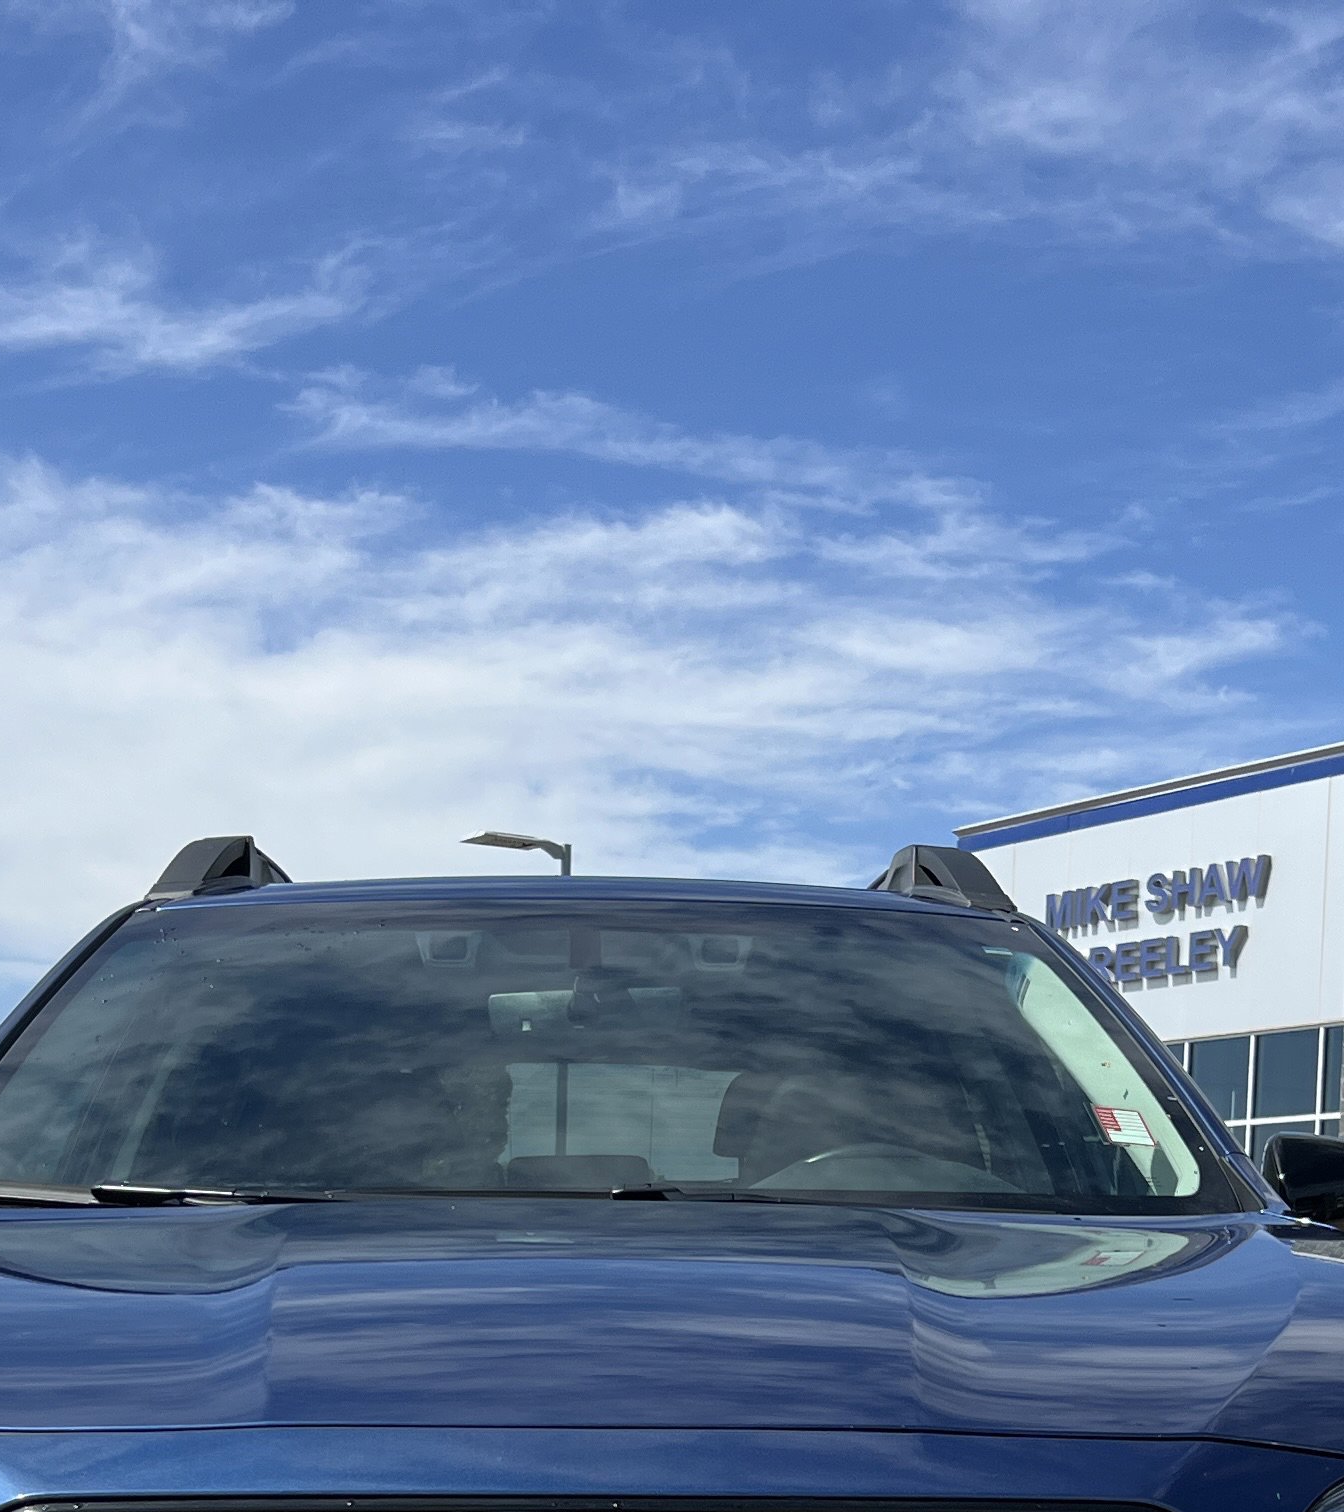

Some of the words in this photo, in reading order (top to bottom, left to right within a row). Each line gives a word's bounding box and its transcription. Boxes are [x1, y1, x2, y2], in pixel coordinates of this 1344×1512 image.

[1046, 878, 1140, 931] MIKE
[1145, 854, 1272, 915] SHAW
[1085, 924, 1249, 982] REELEY
